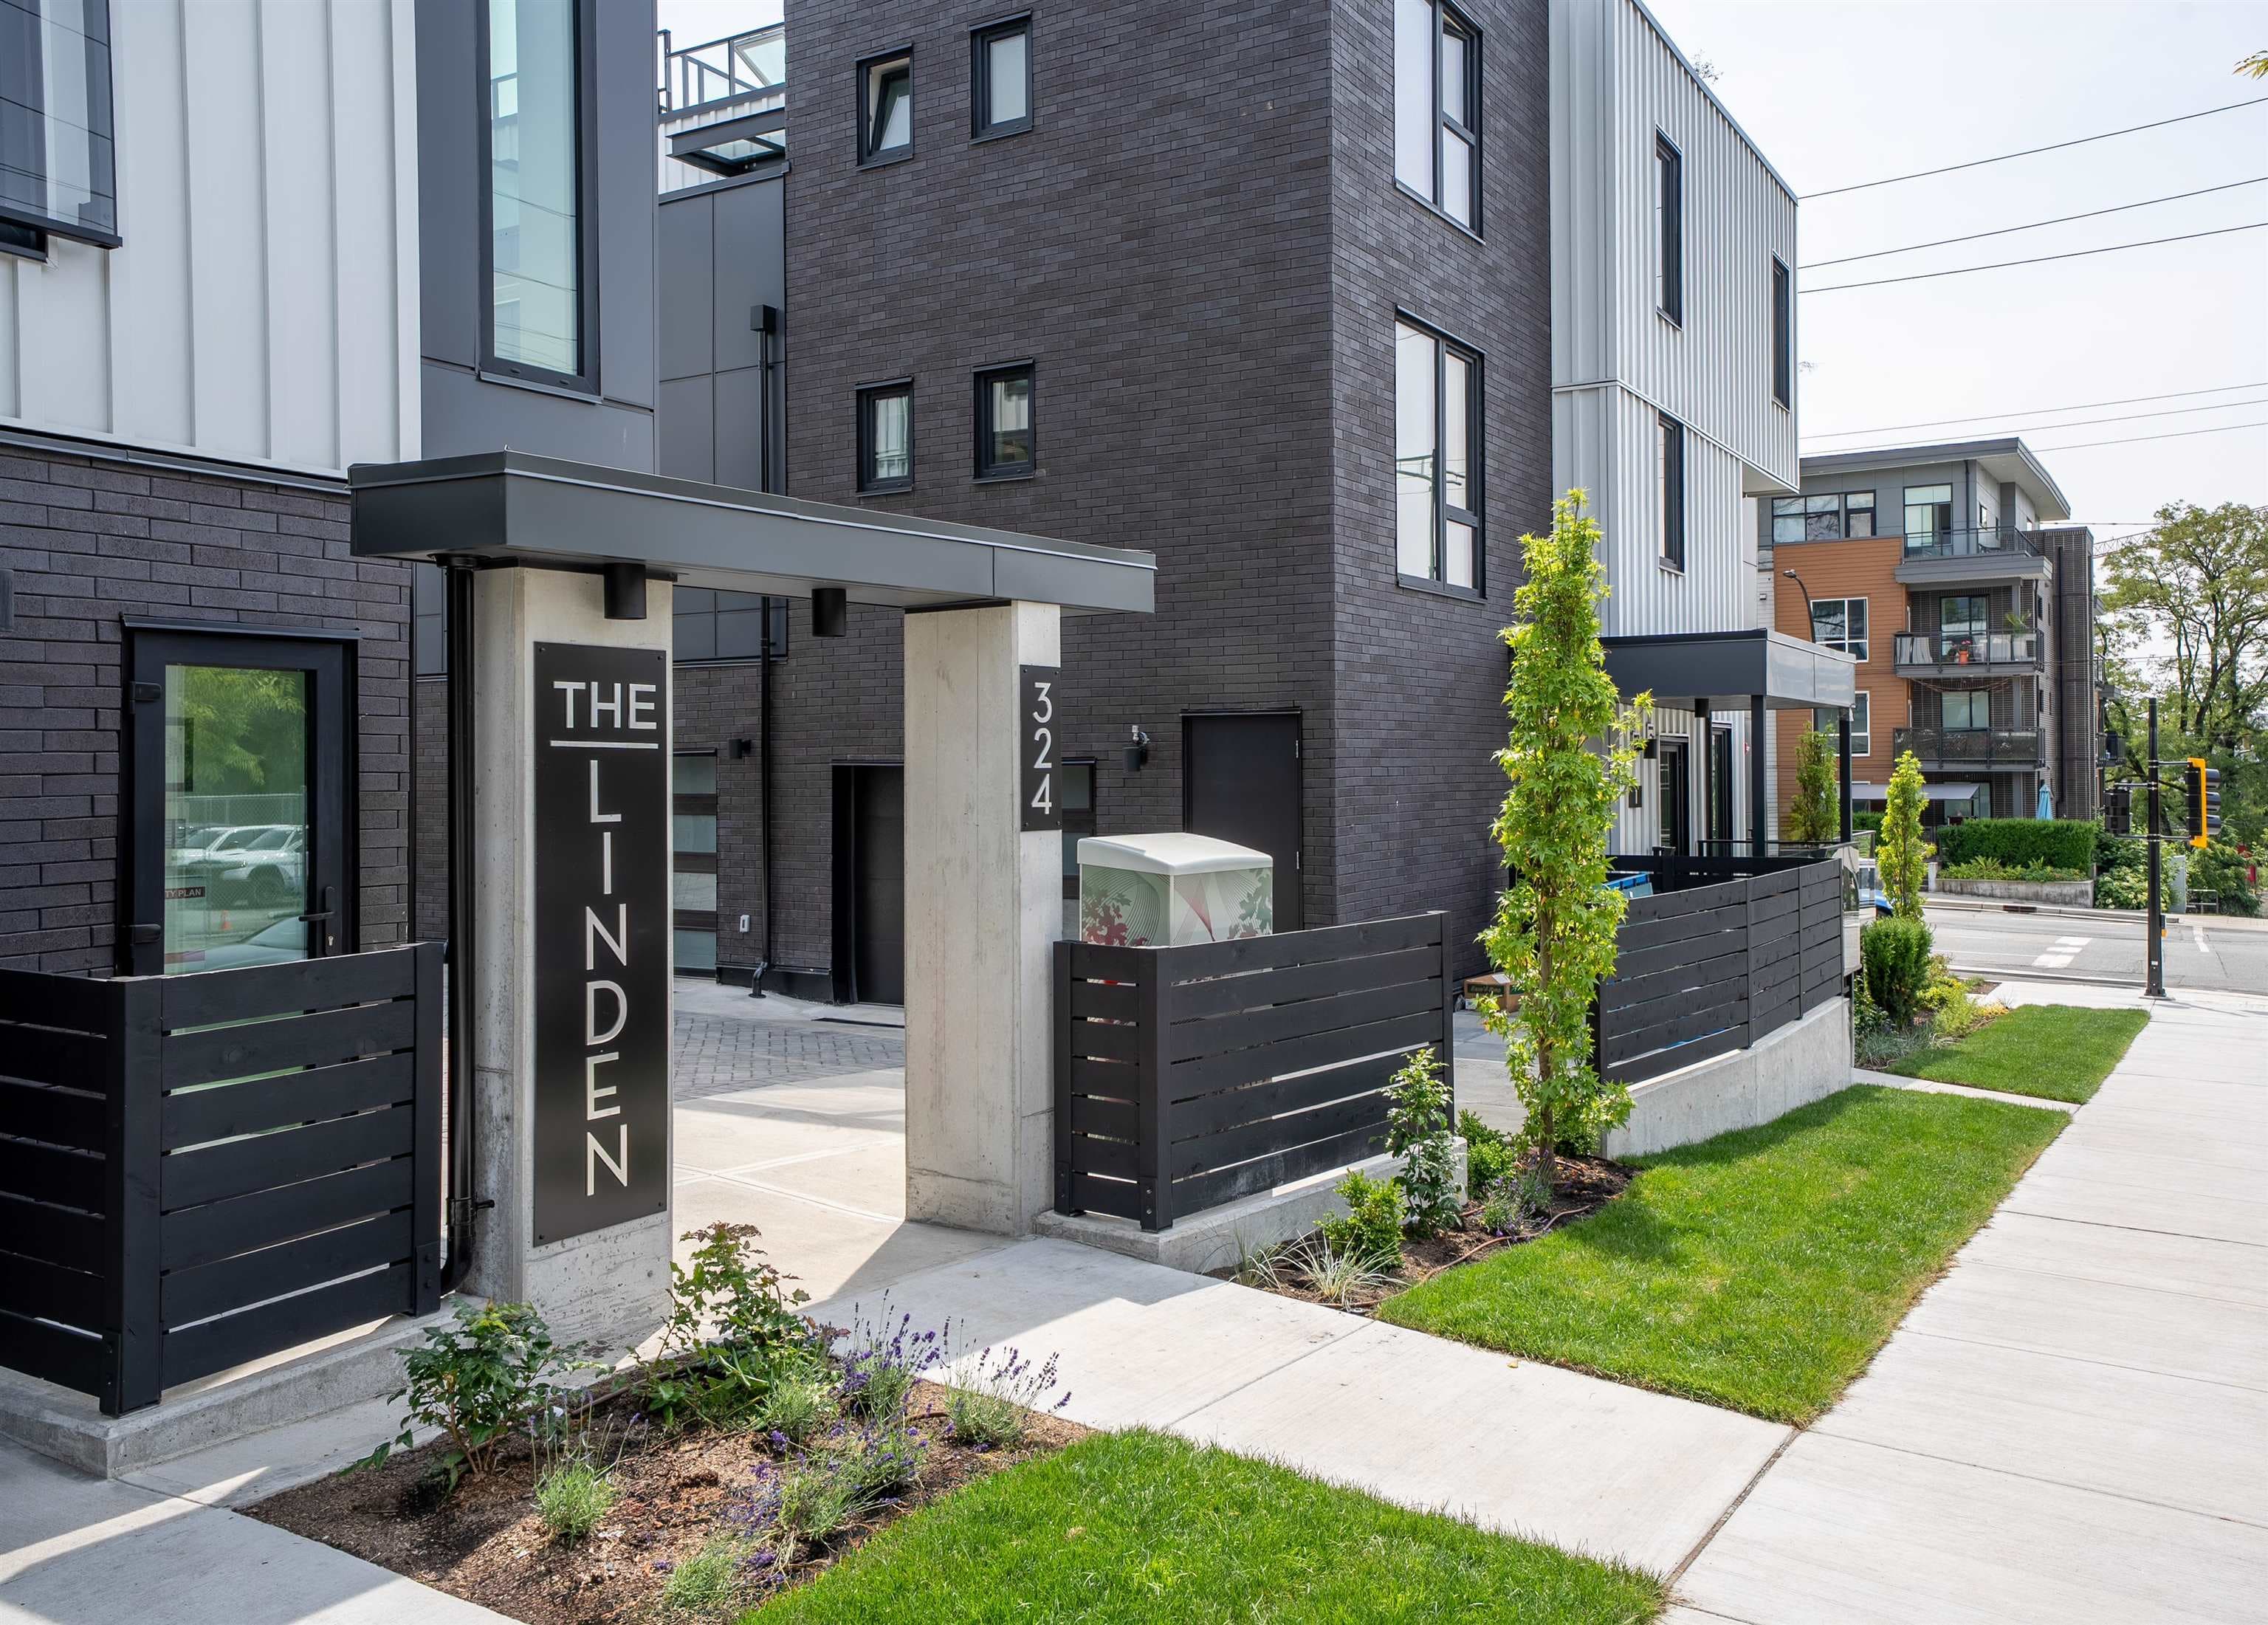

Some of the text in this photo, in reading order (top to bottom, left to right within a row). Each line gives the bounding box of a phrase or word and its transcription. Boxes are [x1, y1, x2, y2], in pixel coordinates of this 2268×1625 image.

[553, 681, 657, 729] THE
[1031, 681, 1053, 815] 324
[178, 888, 202, 898] PLAN
[585, 760, 628, 1197] LINDEN
